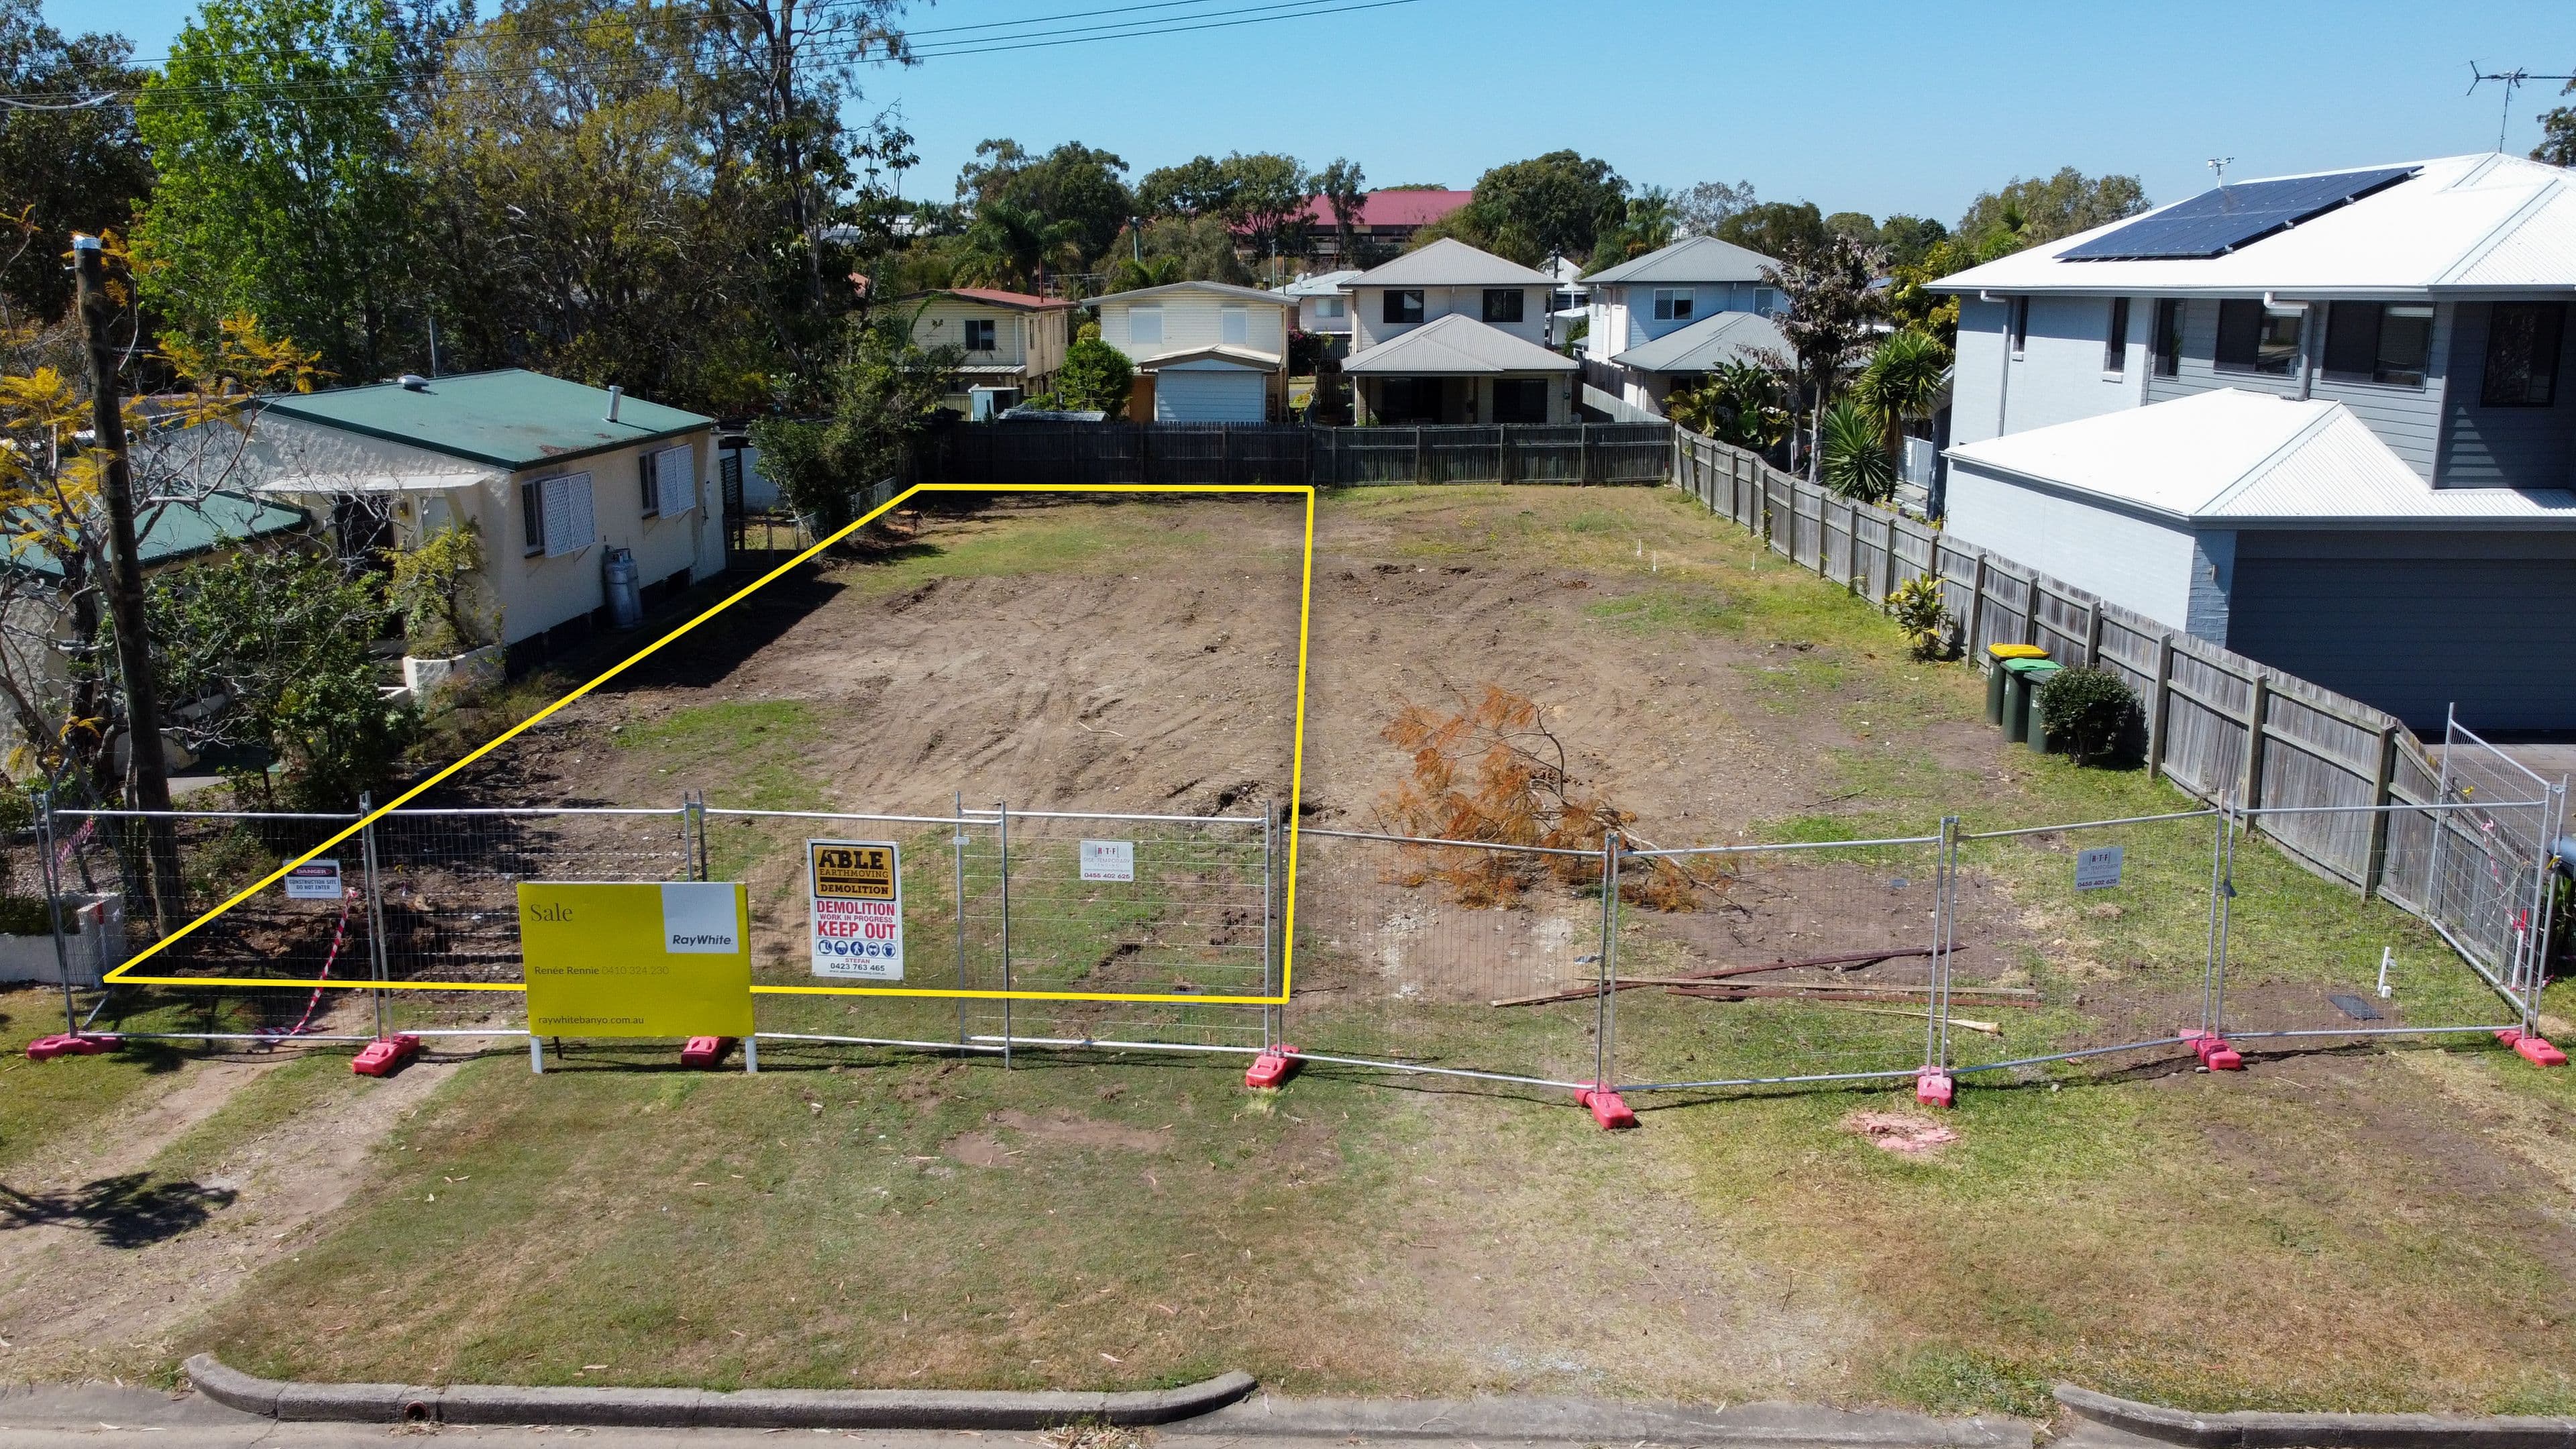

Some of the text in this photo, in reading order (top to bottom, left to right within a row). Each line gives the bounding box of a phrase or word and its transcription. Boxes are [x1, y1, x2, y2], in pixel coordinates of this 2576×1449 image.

[819, 849, 884, 869] ABLE
[819, 868, 889, 878] EARTHMOVING
[820, 884, 889, 895] DEMOLITION
[530, 903, 574, 922] Sale
[816, 900, 896, 916] DEMOLITION
[853, 915, 894, 923] PROGRESS
[818, 920, 896, 940] KEEP OUT
[534, 965, 564, 975] Renée
[567, 966, 600, 975] Rennie
[830, 962, 851, 970] 0423
[538, 1016, 645, 1026] raywhitebanyo.com.au
